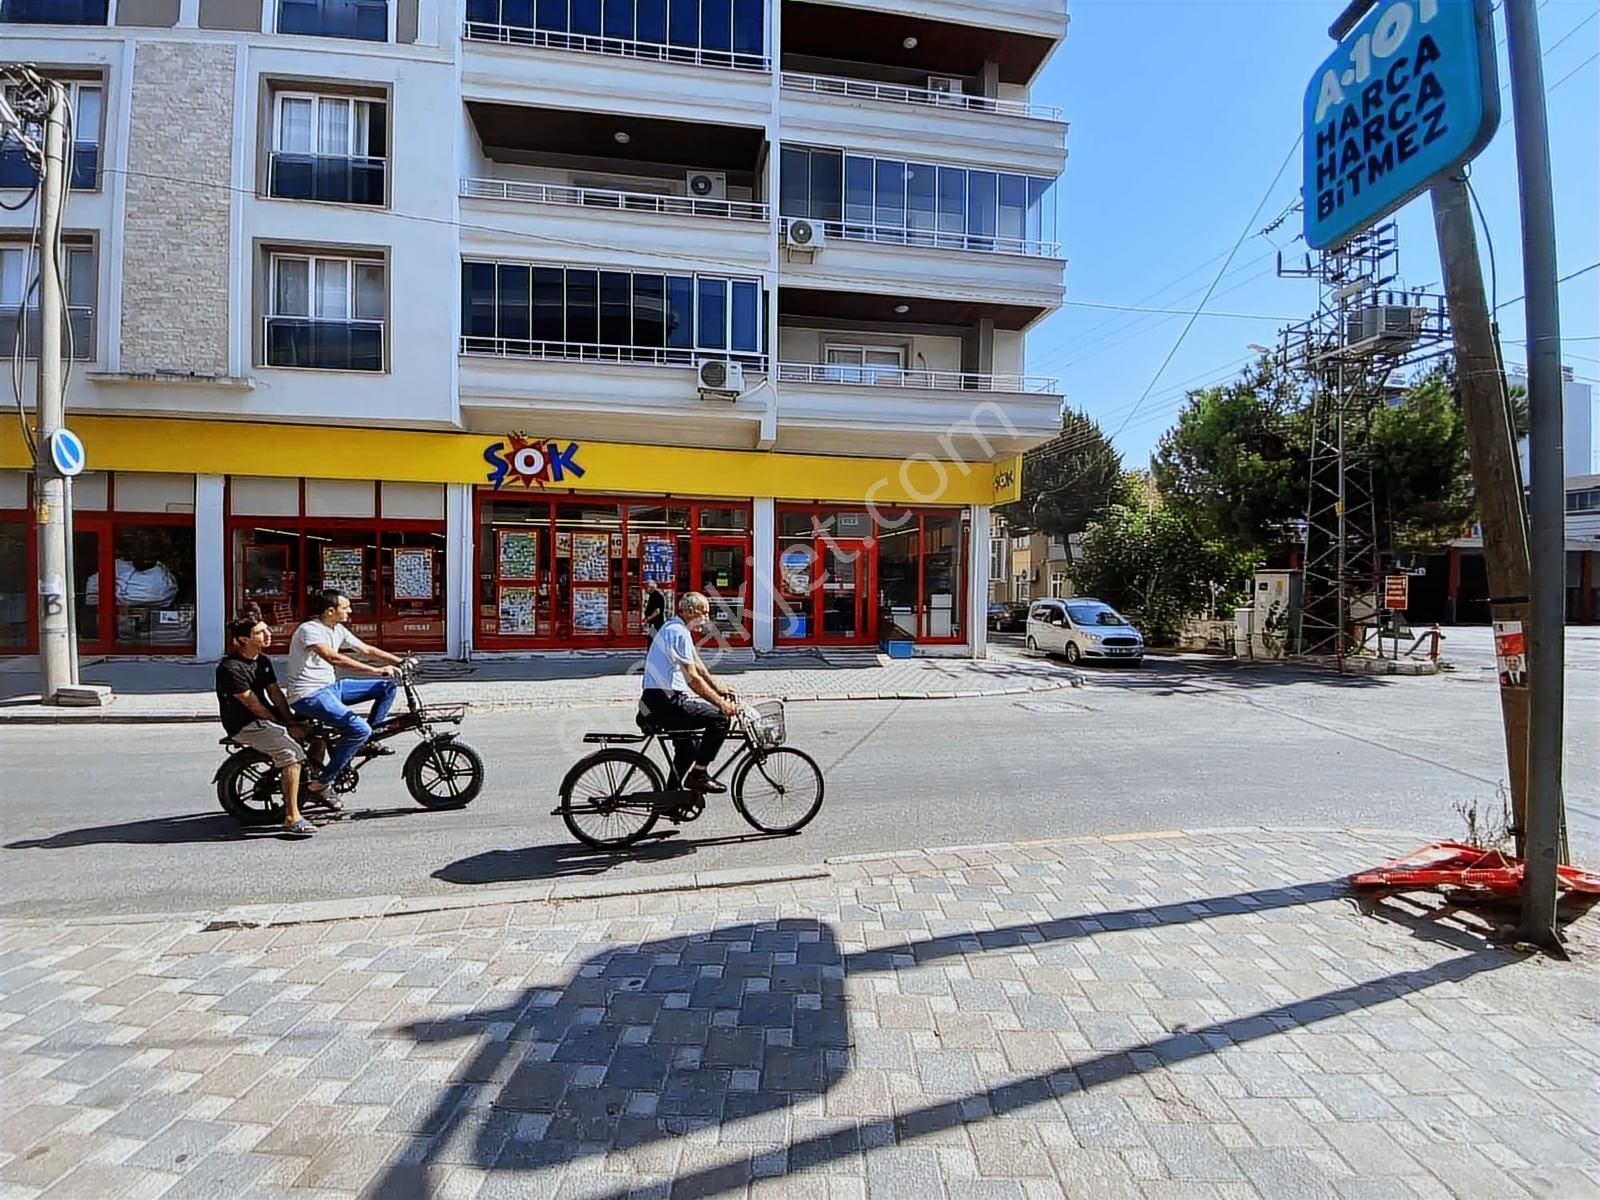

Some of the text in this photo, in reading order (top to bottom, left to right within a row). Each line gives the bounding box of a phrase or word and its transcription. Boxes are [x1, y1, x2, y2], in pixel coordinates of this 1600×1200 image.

[1317, 35, 1441, 160] HARCA
[1317, 73, 1445, 190] HARCA
[484, 440, 585, 491] ŞOK
